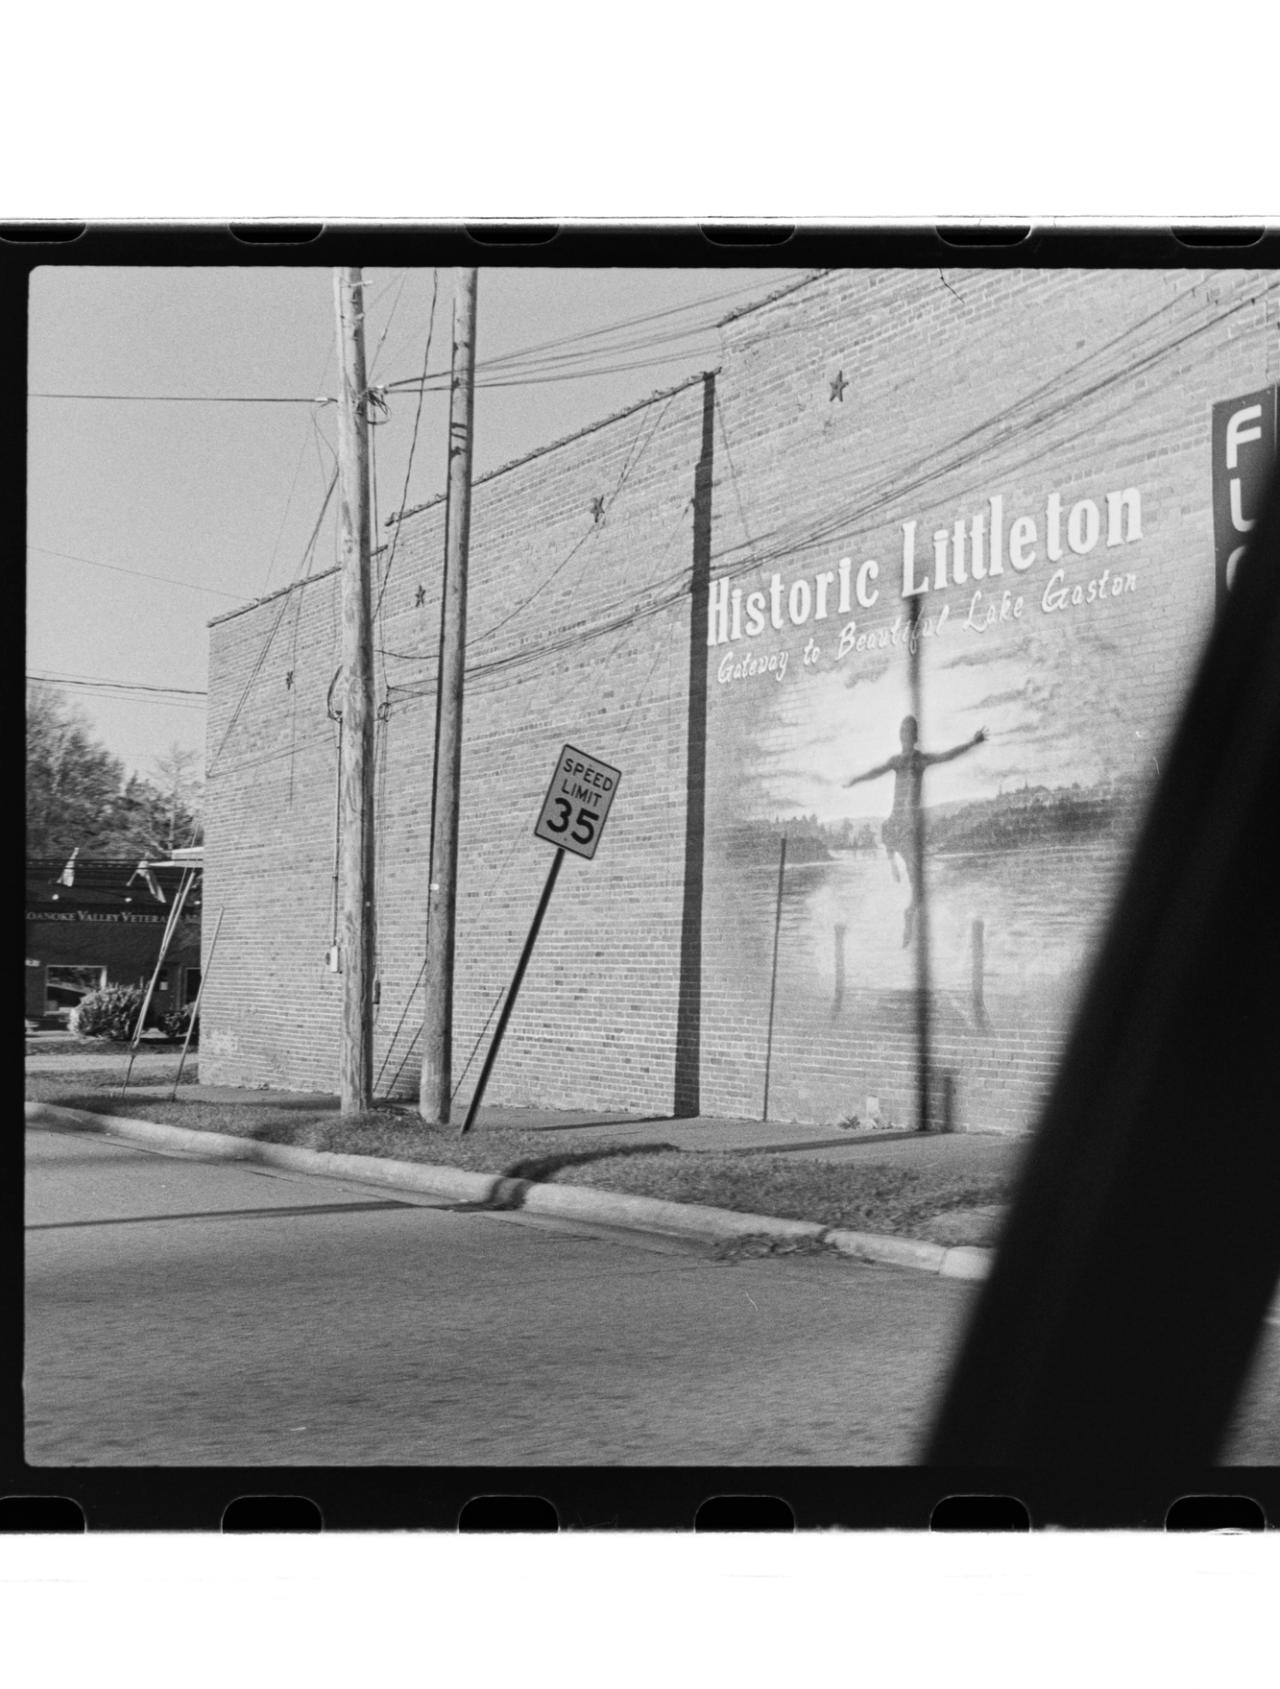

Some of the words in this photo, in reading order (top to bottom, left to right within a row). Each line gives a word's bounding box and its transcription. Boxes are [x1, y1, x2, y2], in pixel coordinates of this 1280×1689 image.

[707, 556, 879, 646] Historic
[901, 486, 1143, 598] Littleton
[717, 651, 788, 684] Gateway
[803, 638, 820, 665] to
[836, 604, 949, 662] Beautiful
[962, 589, 1024, 633] Lake
[1041, 568, 1137, 613] Gaston
[561, 778, 602, 807] LIMIT
[562, 757, 614, 792] SPEED
[546, 797, 600, 845] 35
